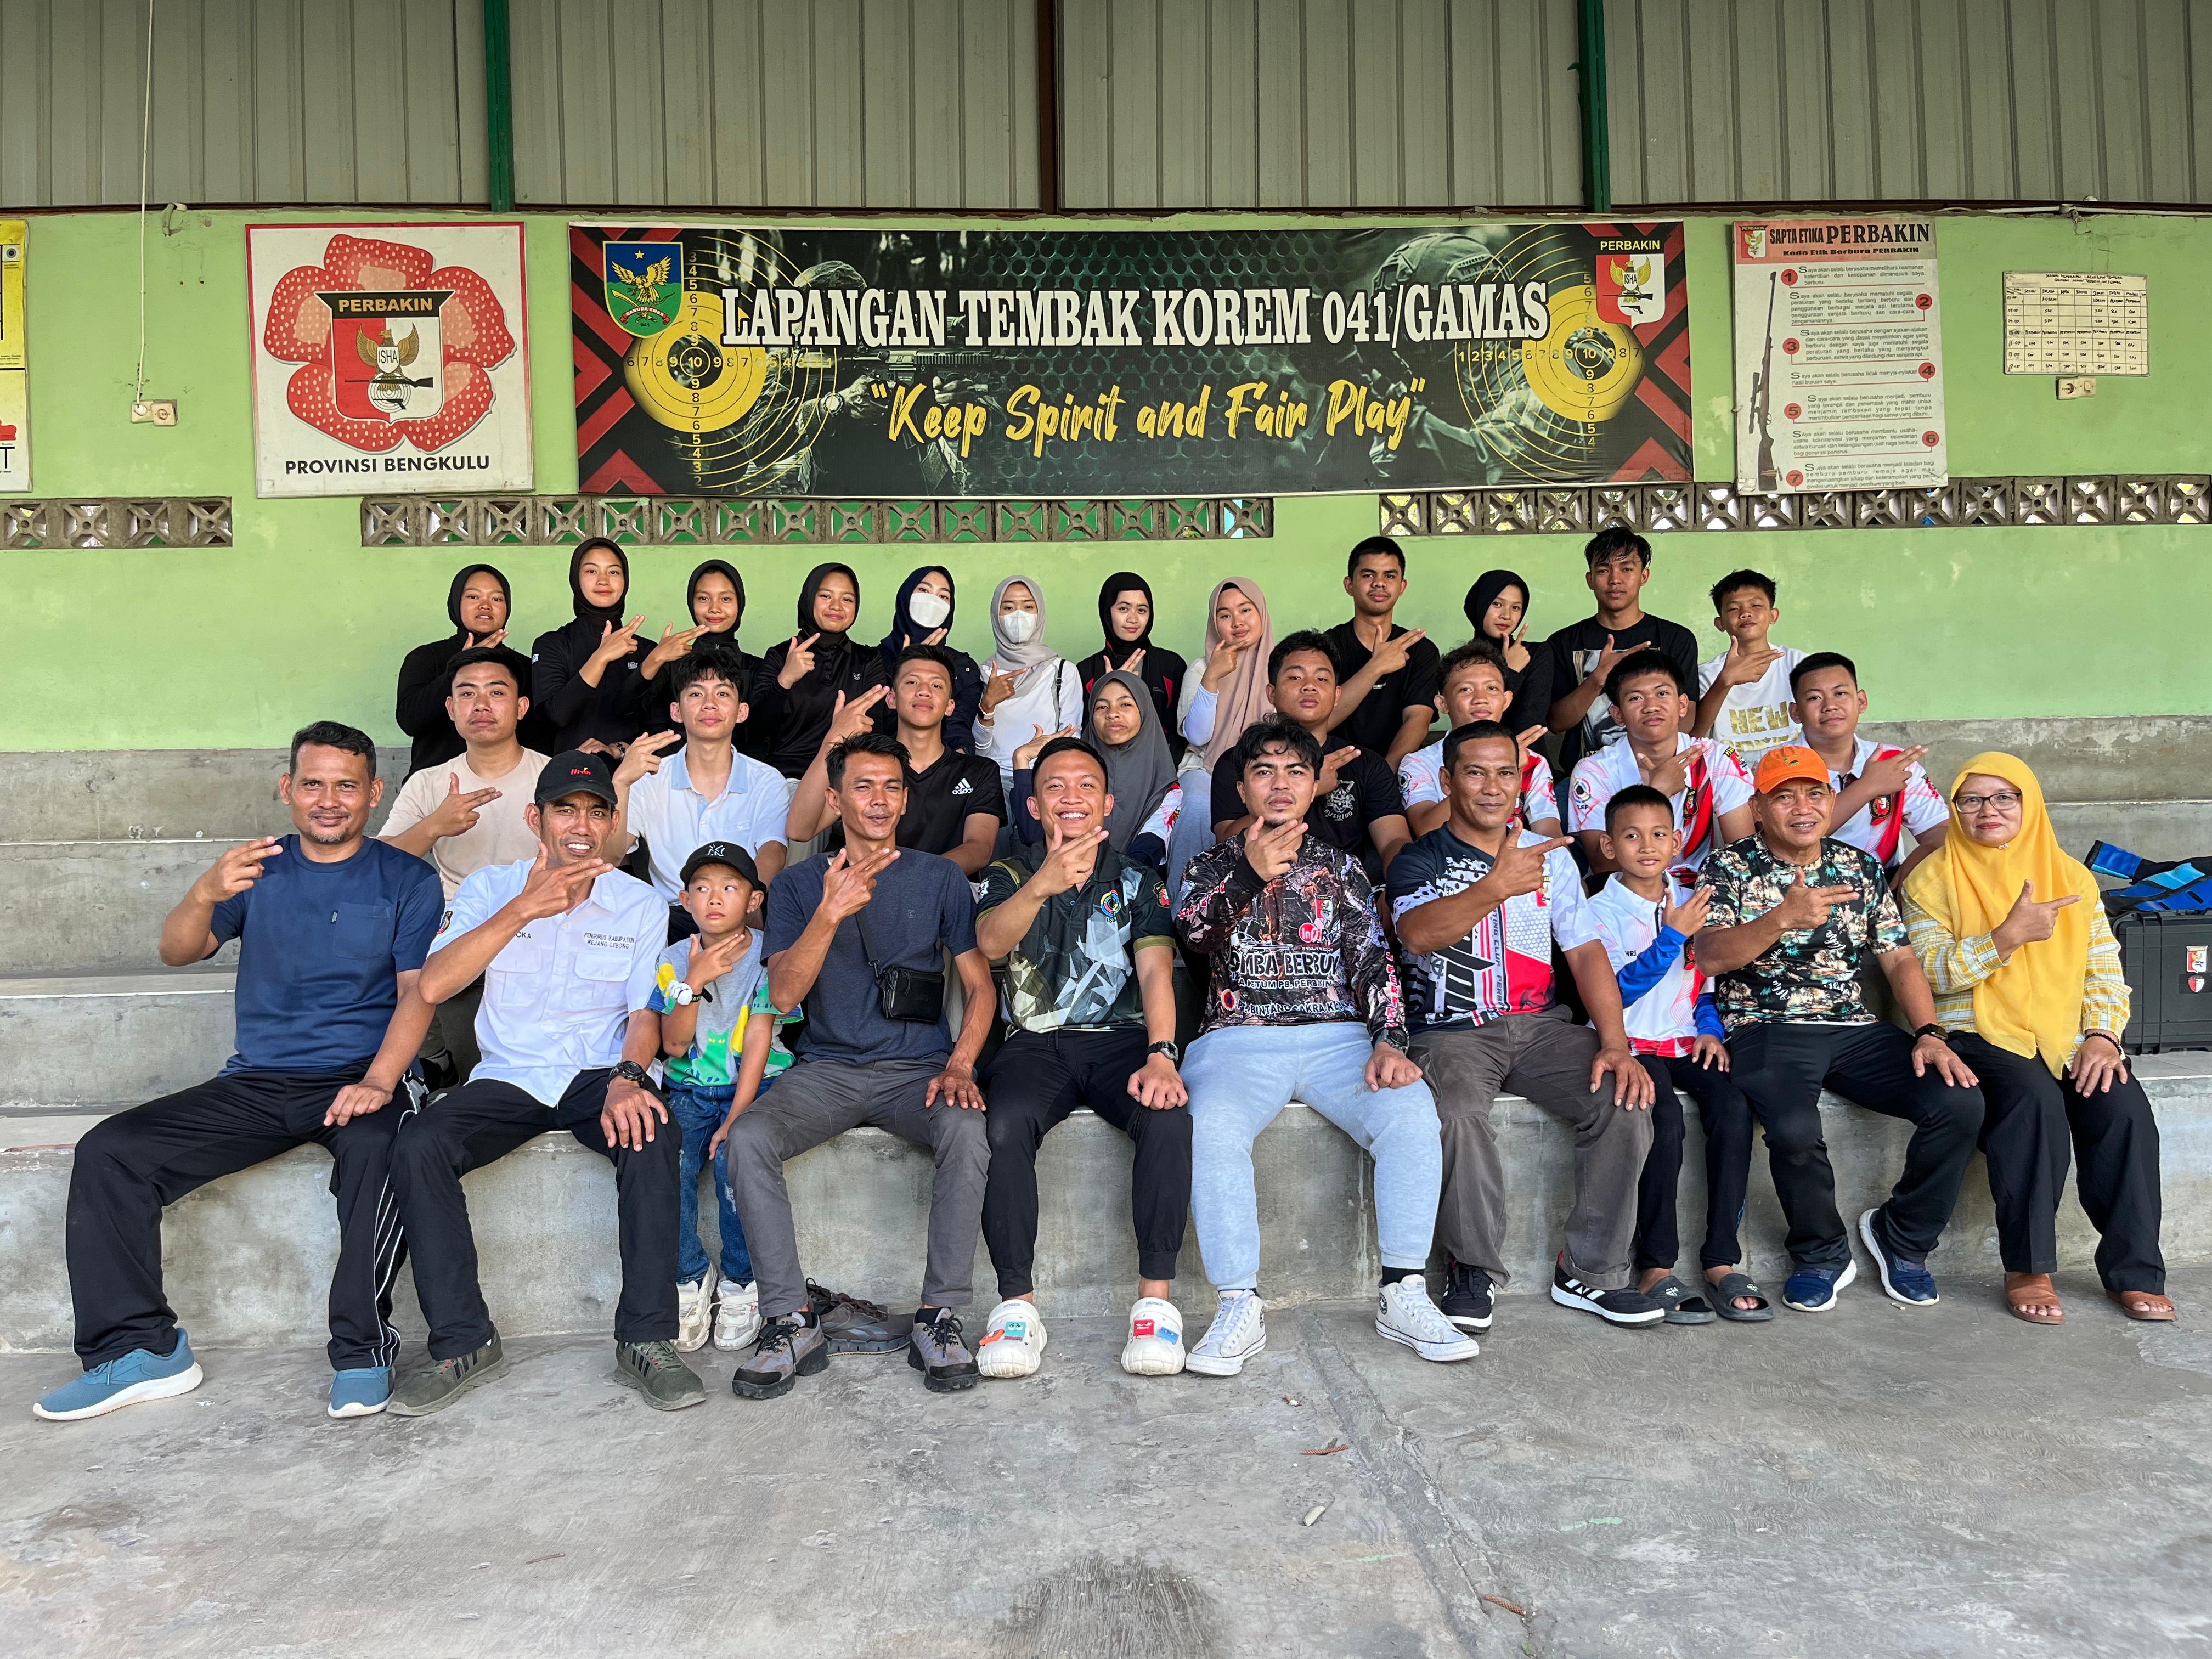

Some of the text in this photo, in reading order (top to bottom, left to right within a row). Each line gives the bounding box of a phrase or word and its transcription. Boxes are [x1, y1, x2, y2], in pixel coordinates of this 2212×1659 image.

[1770, 224, 1929, 244] SAPTA ETIKA PERBAKIN
[1600, 240, 1661, 251] PERBAKIN
[1624, 273, 1638, 284] ISHA
[1785, 273, 1792, 282] 1
[338, 298, 433, 312] PERBAKIN
[1919, 297, 1929, 307] 2
[721, 281, 1548, 348] LAPANGAN TEMBAK KOREM 041/GAMAS
[1787, 342, 1797, 351] 3
[379, 349, 398, 364] ISHA
[1922, 366, 1933, 375] 4
[1788, 407, 1798, 416] 5
[871, 377, 1426, 458] "Keep Spirit and Fair Play"
[1926, 435, 1936, 443] 6
[285, 455, 489, 475] PROVINSI BENGKULU
[1790, 473, 1800, 483] 7
[1729, 701, 1789, 734] NEW
[584, 932, 634, 943] PENGURUS KABUPATEN
[588, 939, 607, 947] REJANG
